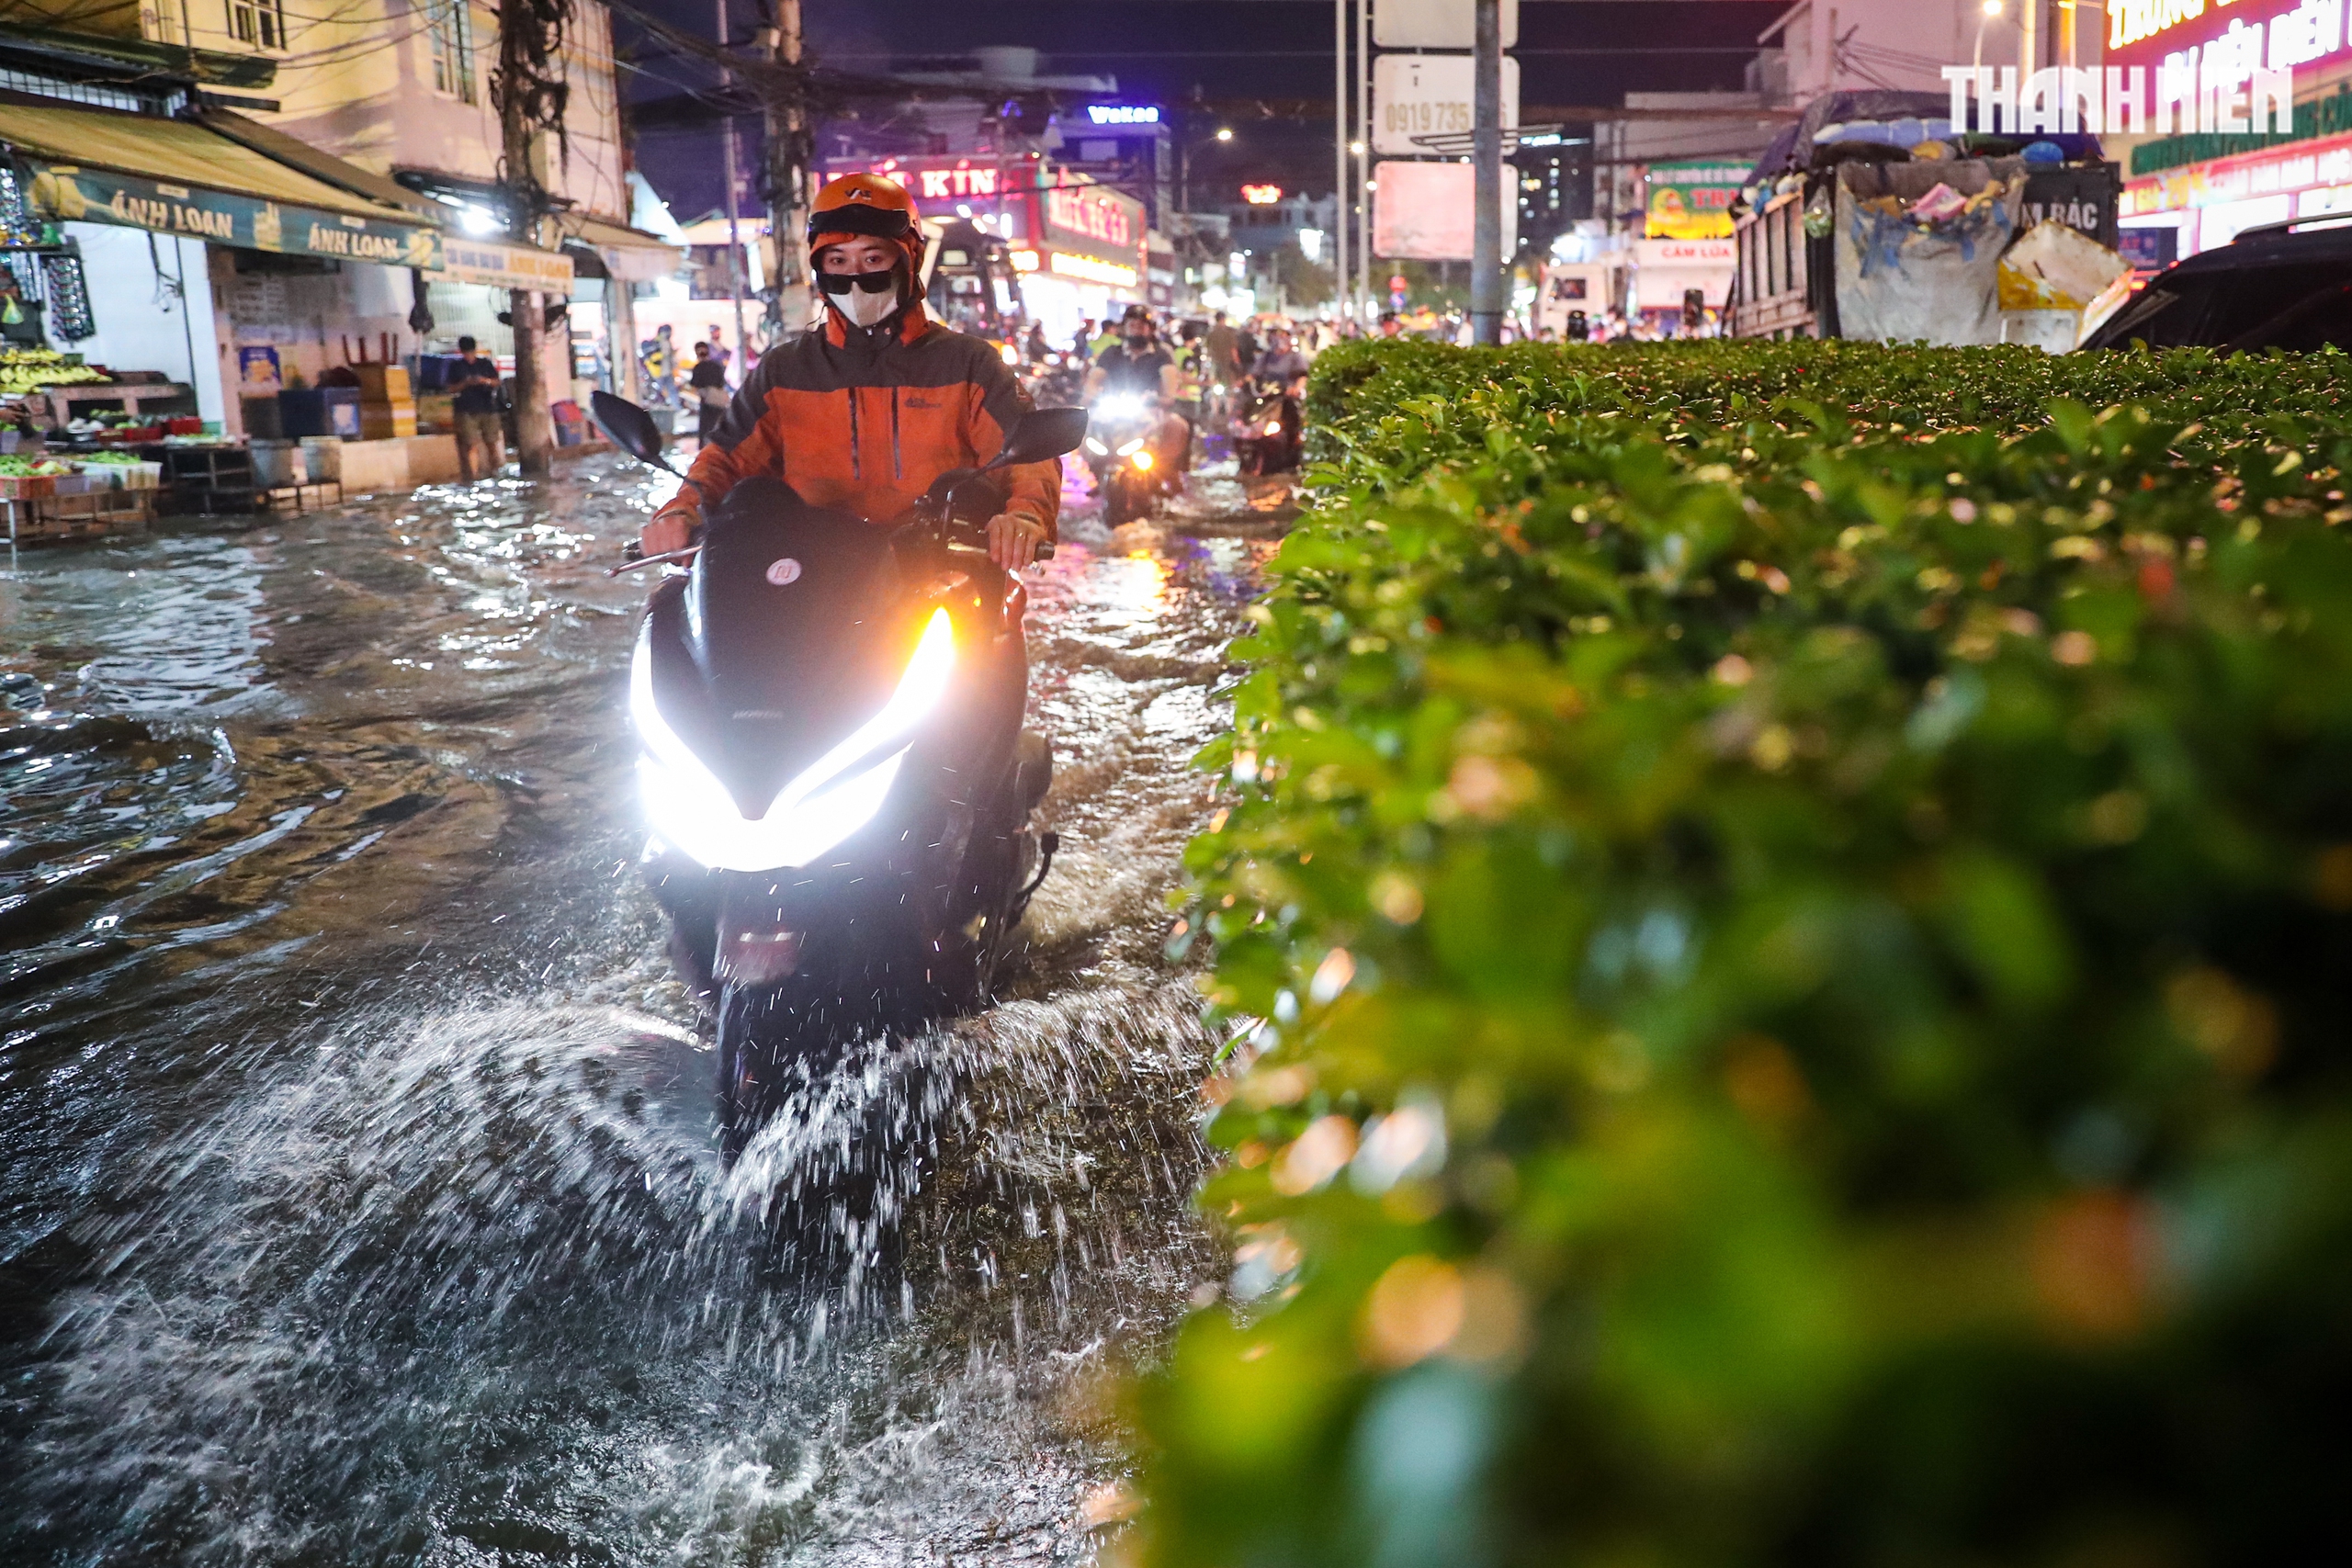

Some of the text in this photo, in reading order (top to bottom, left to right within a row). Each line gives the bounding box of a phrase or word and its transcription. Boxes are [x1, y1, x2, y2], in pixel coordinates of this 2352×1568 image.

[1385, 102, 1430, 133] 0919
[1435, 102, 1469, 133] 735
[111, 189, 233, 239] ÁNH LOAN
[308, 222, 400, 260] ÁNH LOAN
